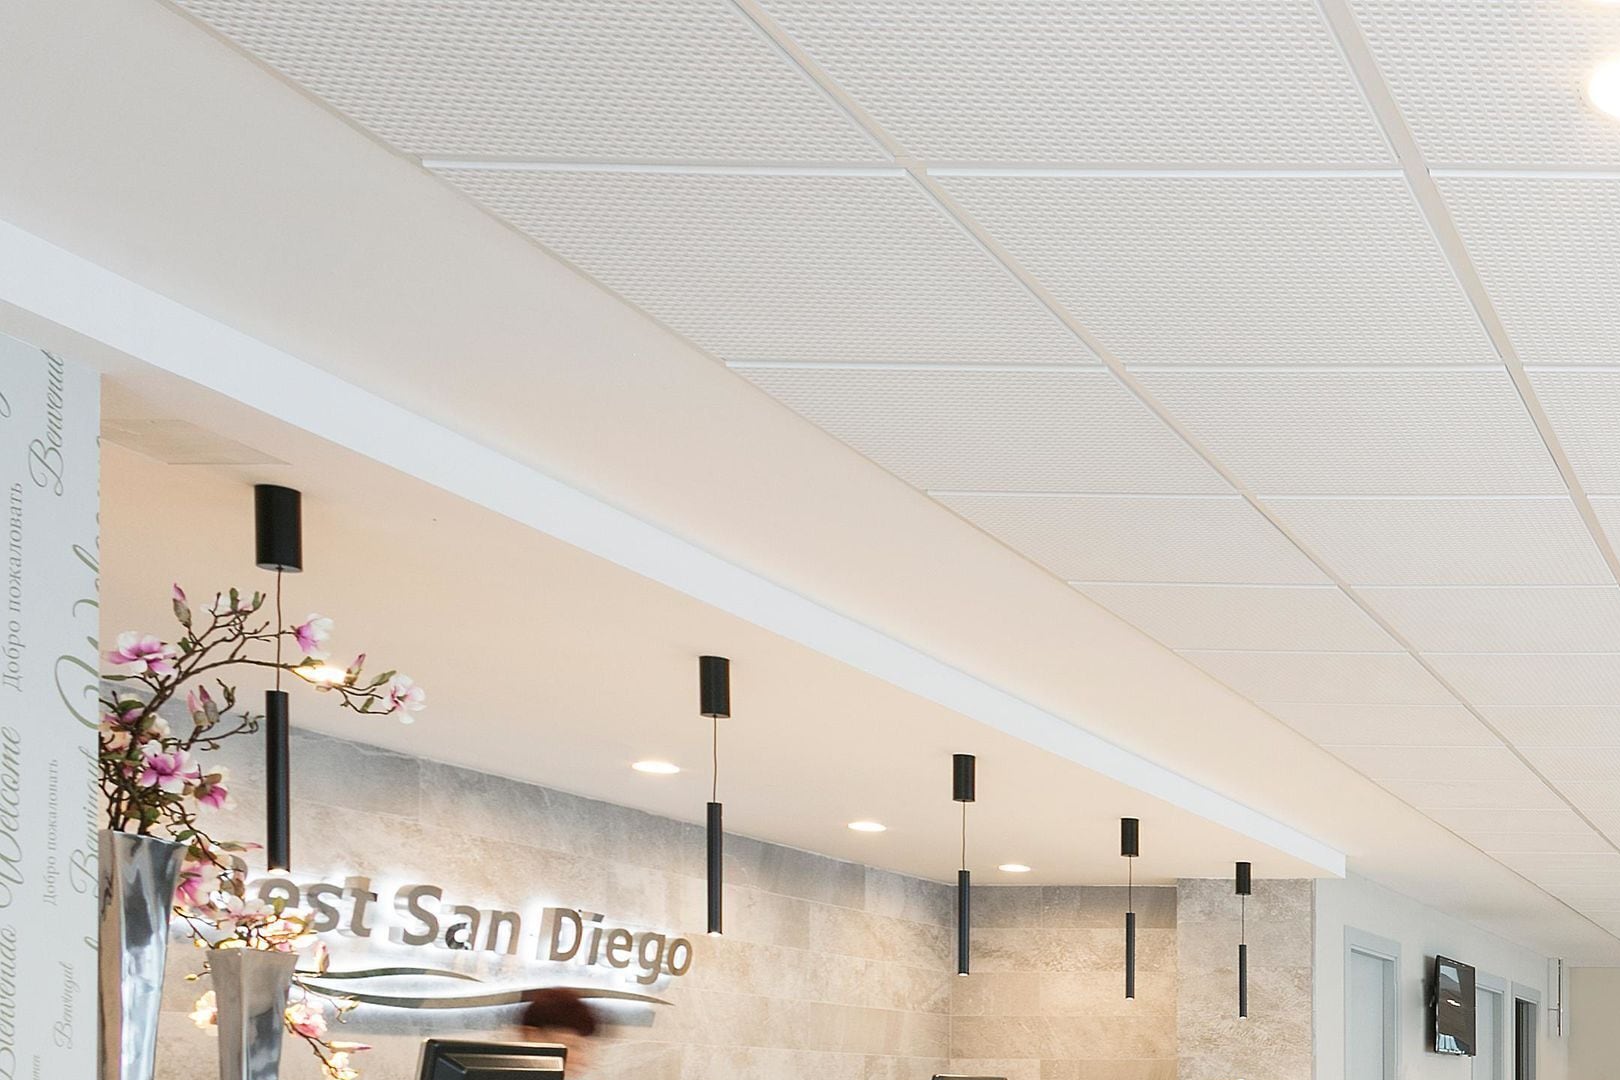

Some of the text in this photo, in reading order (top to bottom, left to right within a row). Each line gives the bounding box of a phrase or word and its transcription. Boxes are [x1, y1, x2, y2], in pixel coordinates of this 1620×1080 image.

[2, 482, 26, 693] Добро пожаловать
[42, 759, 60, 906] Добро пожаловать
[395, 883, 520, 955] San
[540, 905, 693, 986] Diego
[53, 960, 80, 1050] Benvingut
